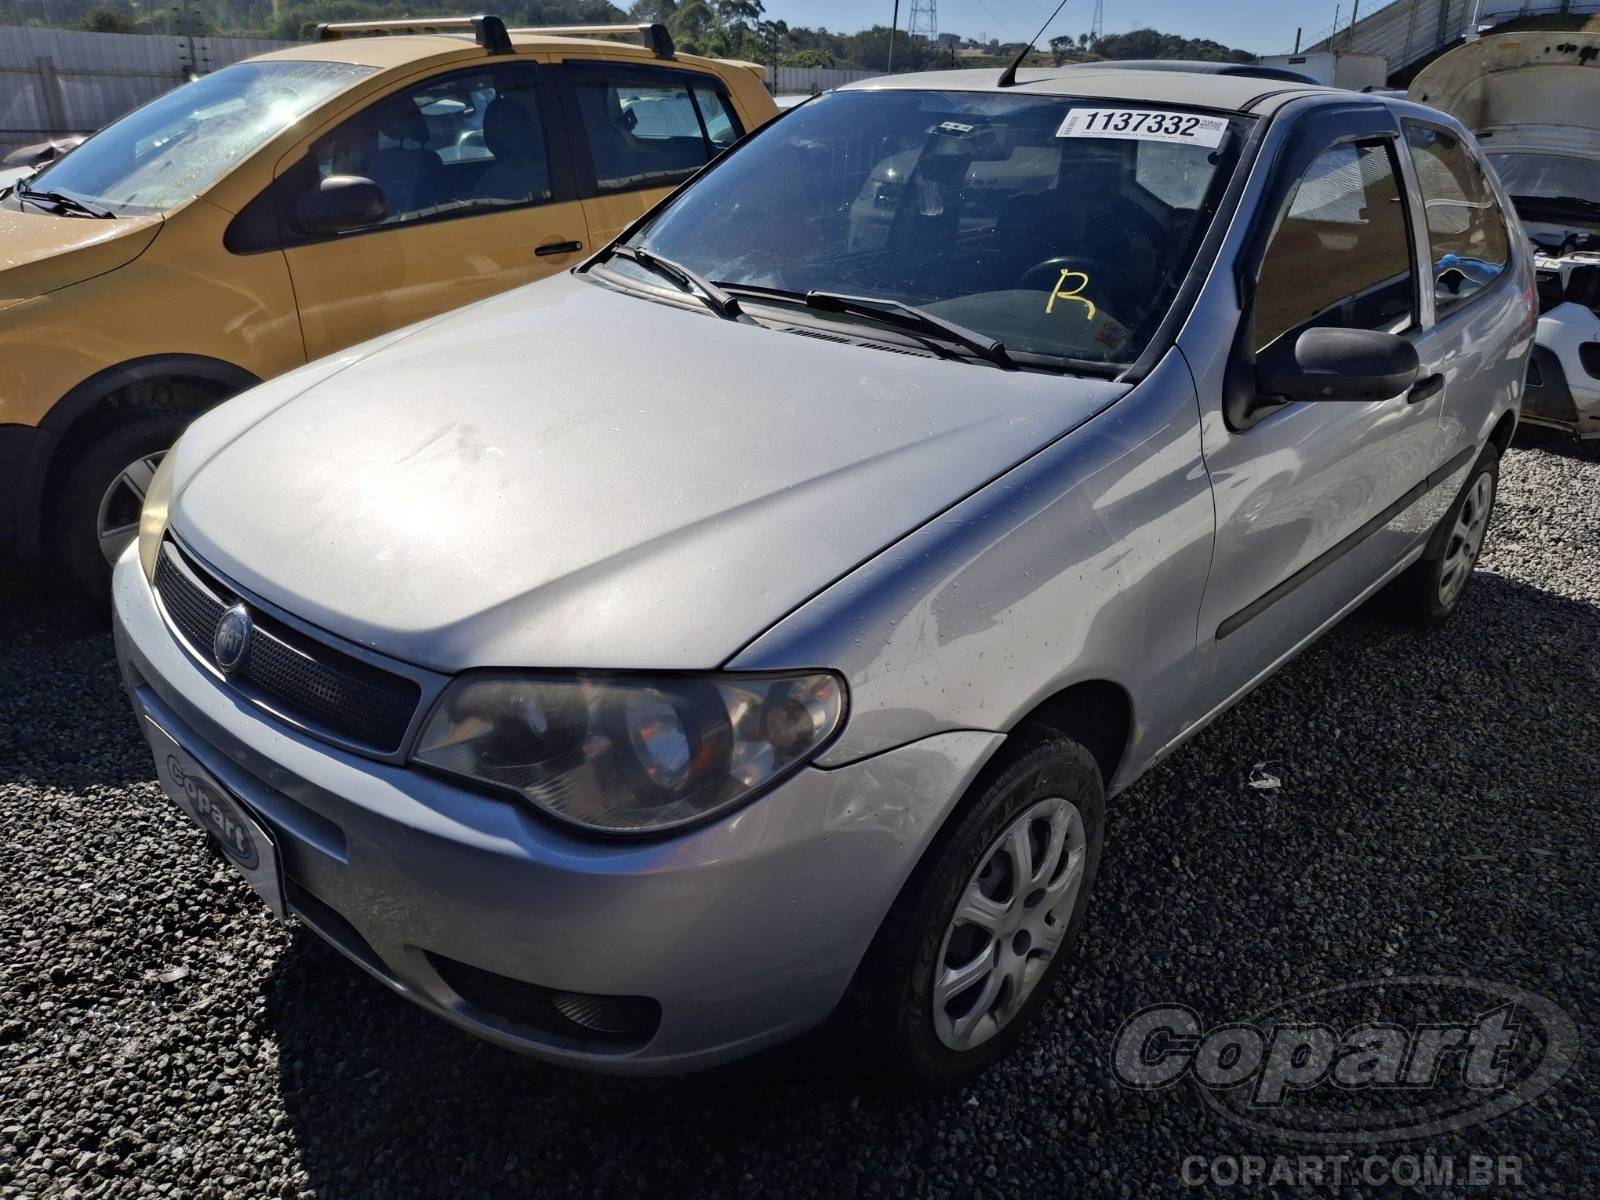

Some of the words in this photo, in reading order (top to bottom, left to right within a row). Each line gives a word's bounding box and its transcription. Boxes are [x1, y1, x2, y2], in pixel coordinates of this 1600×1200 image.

[1086, 112, 1200, 137] 1137332
[1046, 268, 1096, 321] R
[167, 754, 246, 854] Copart
